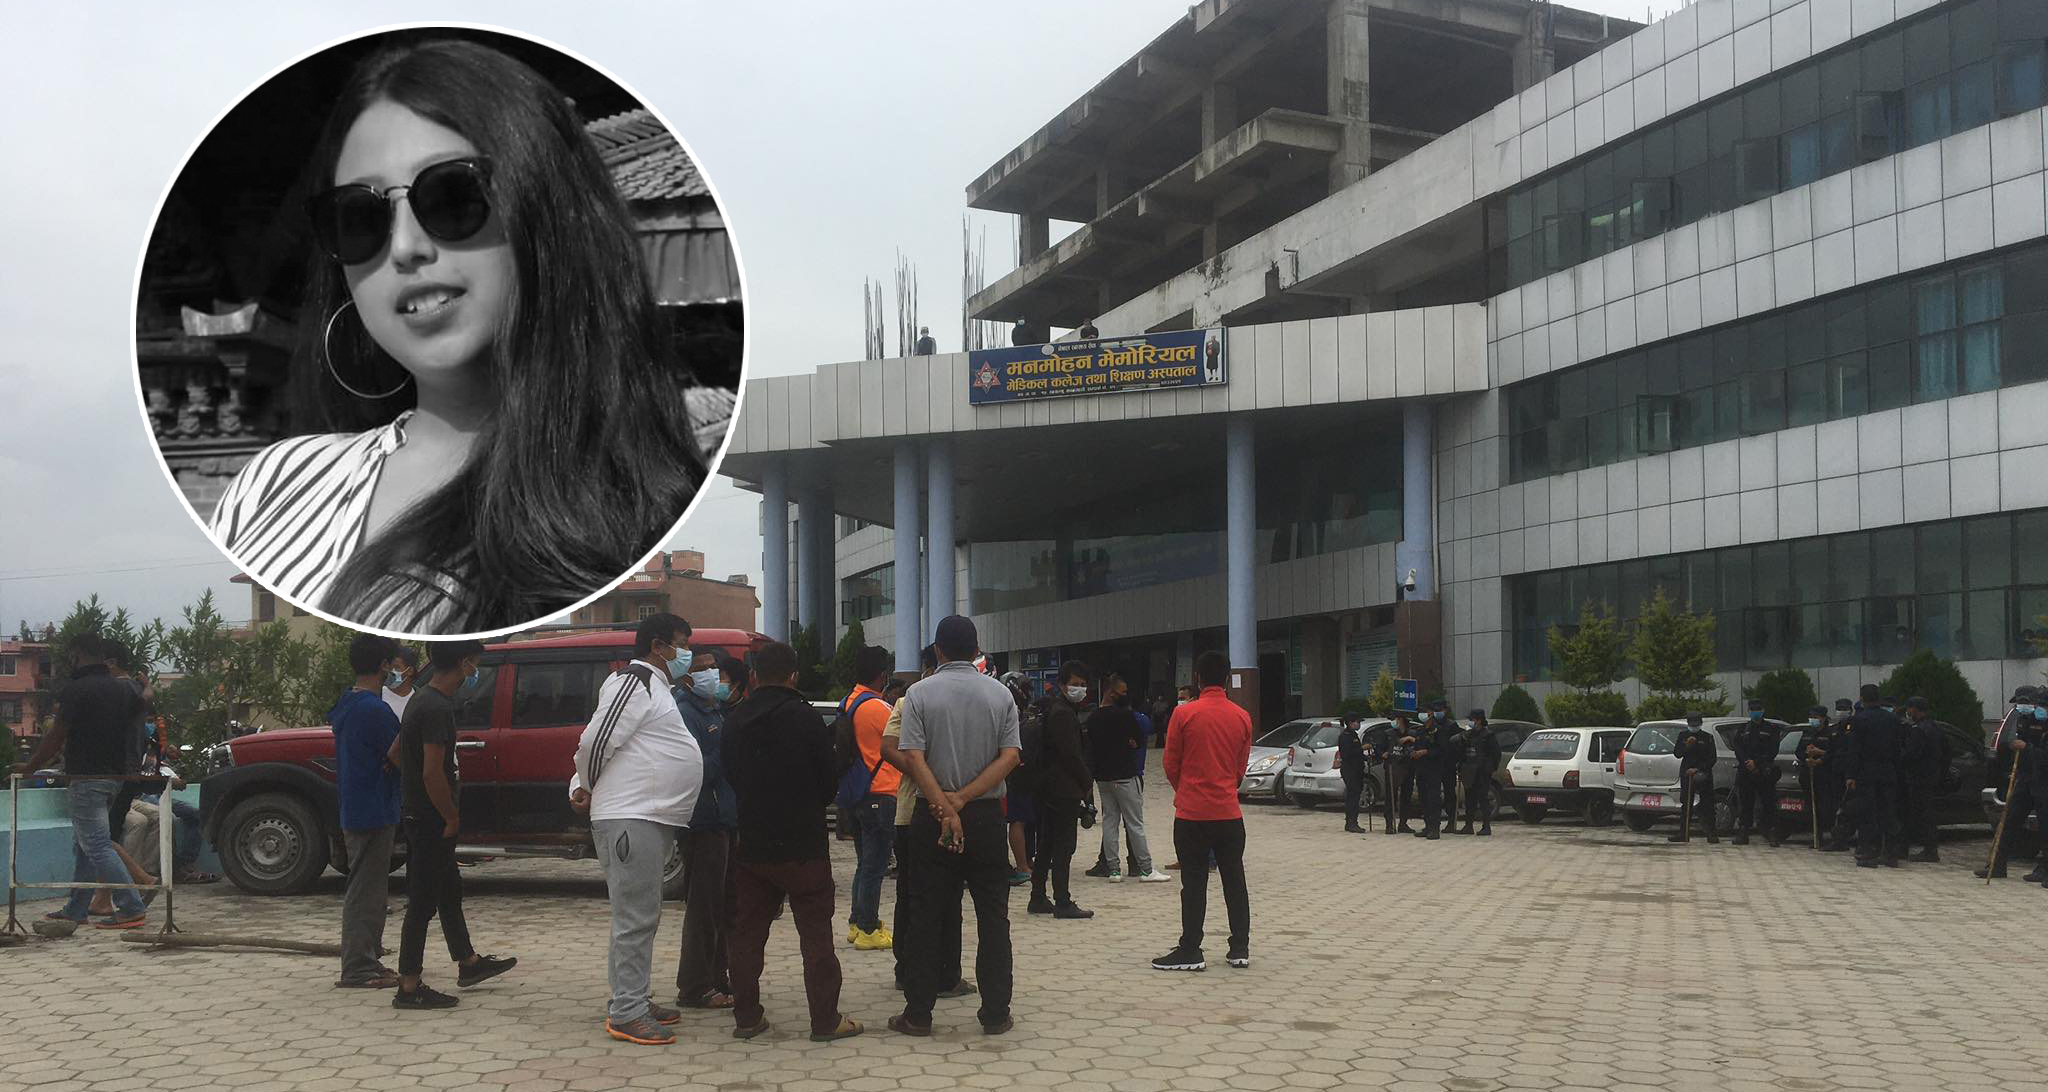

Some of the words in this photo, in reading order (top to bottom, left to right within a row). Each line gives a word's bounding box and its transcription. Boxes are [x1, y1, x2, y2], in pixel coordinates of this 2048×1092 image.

[1006, 353, 1093, 375] मनमोहन
[1098, 344, 1197, 367] मेमोरियल
[1006, 377, 1048, 391] मेडिकल
[1051, 374, 1083, 387] कलेज
[1086, 372, 1107, 385] तथा
[1110, 369, 1145, 383] शिक्षण
[1147, 365, 1197, 379] अस्पताल
